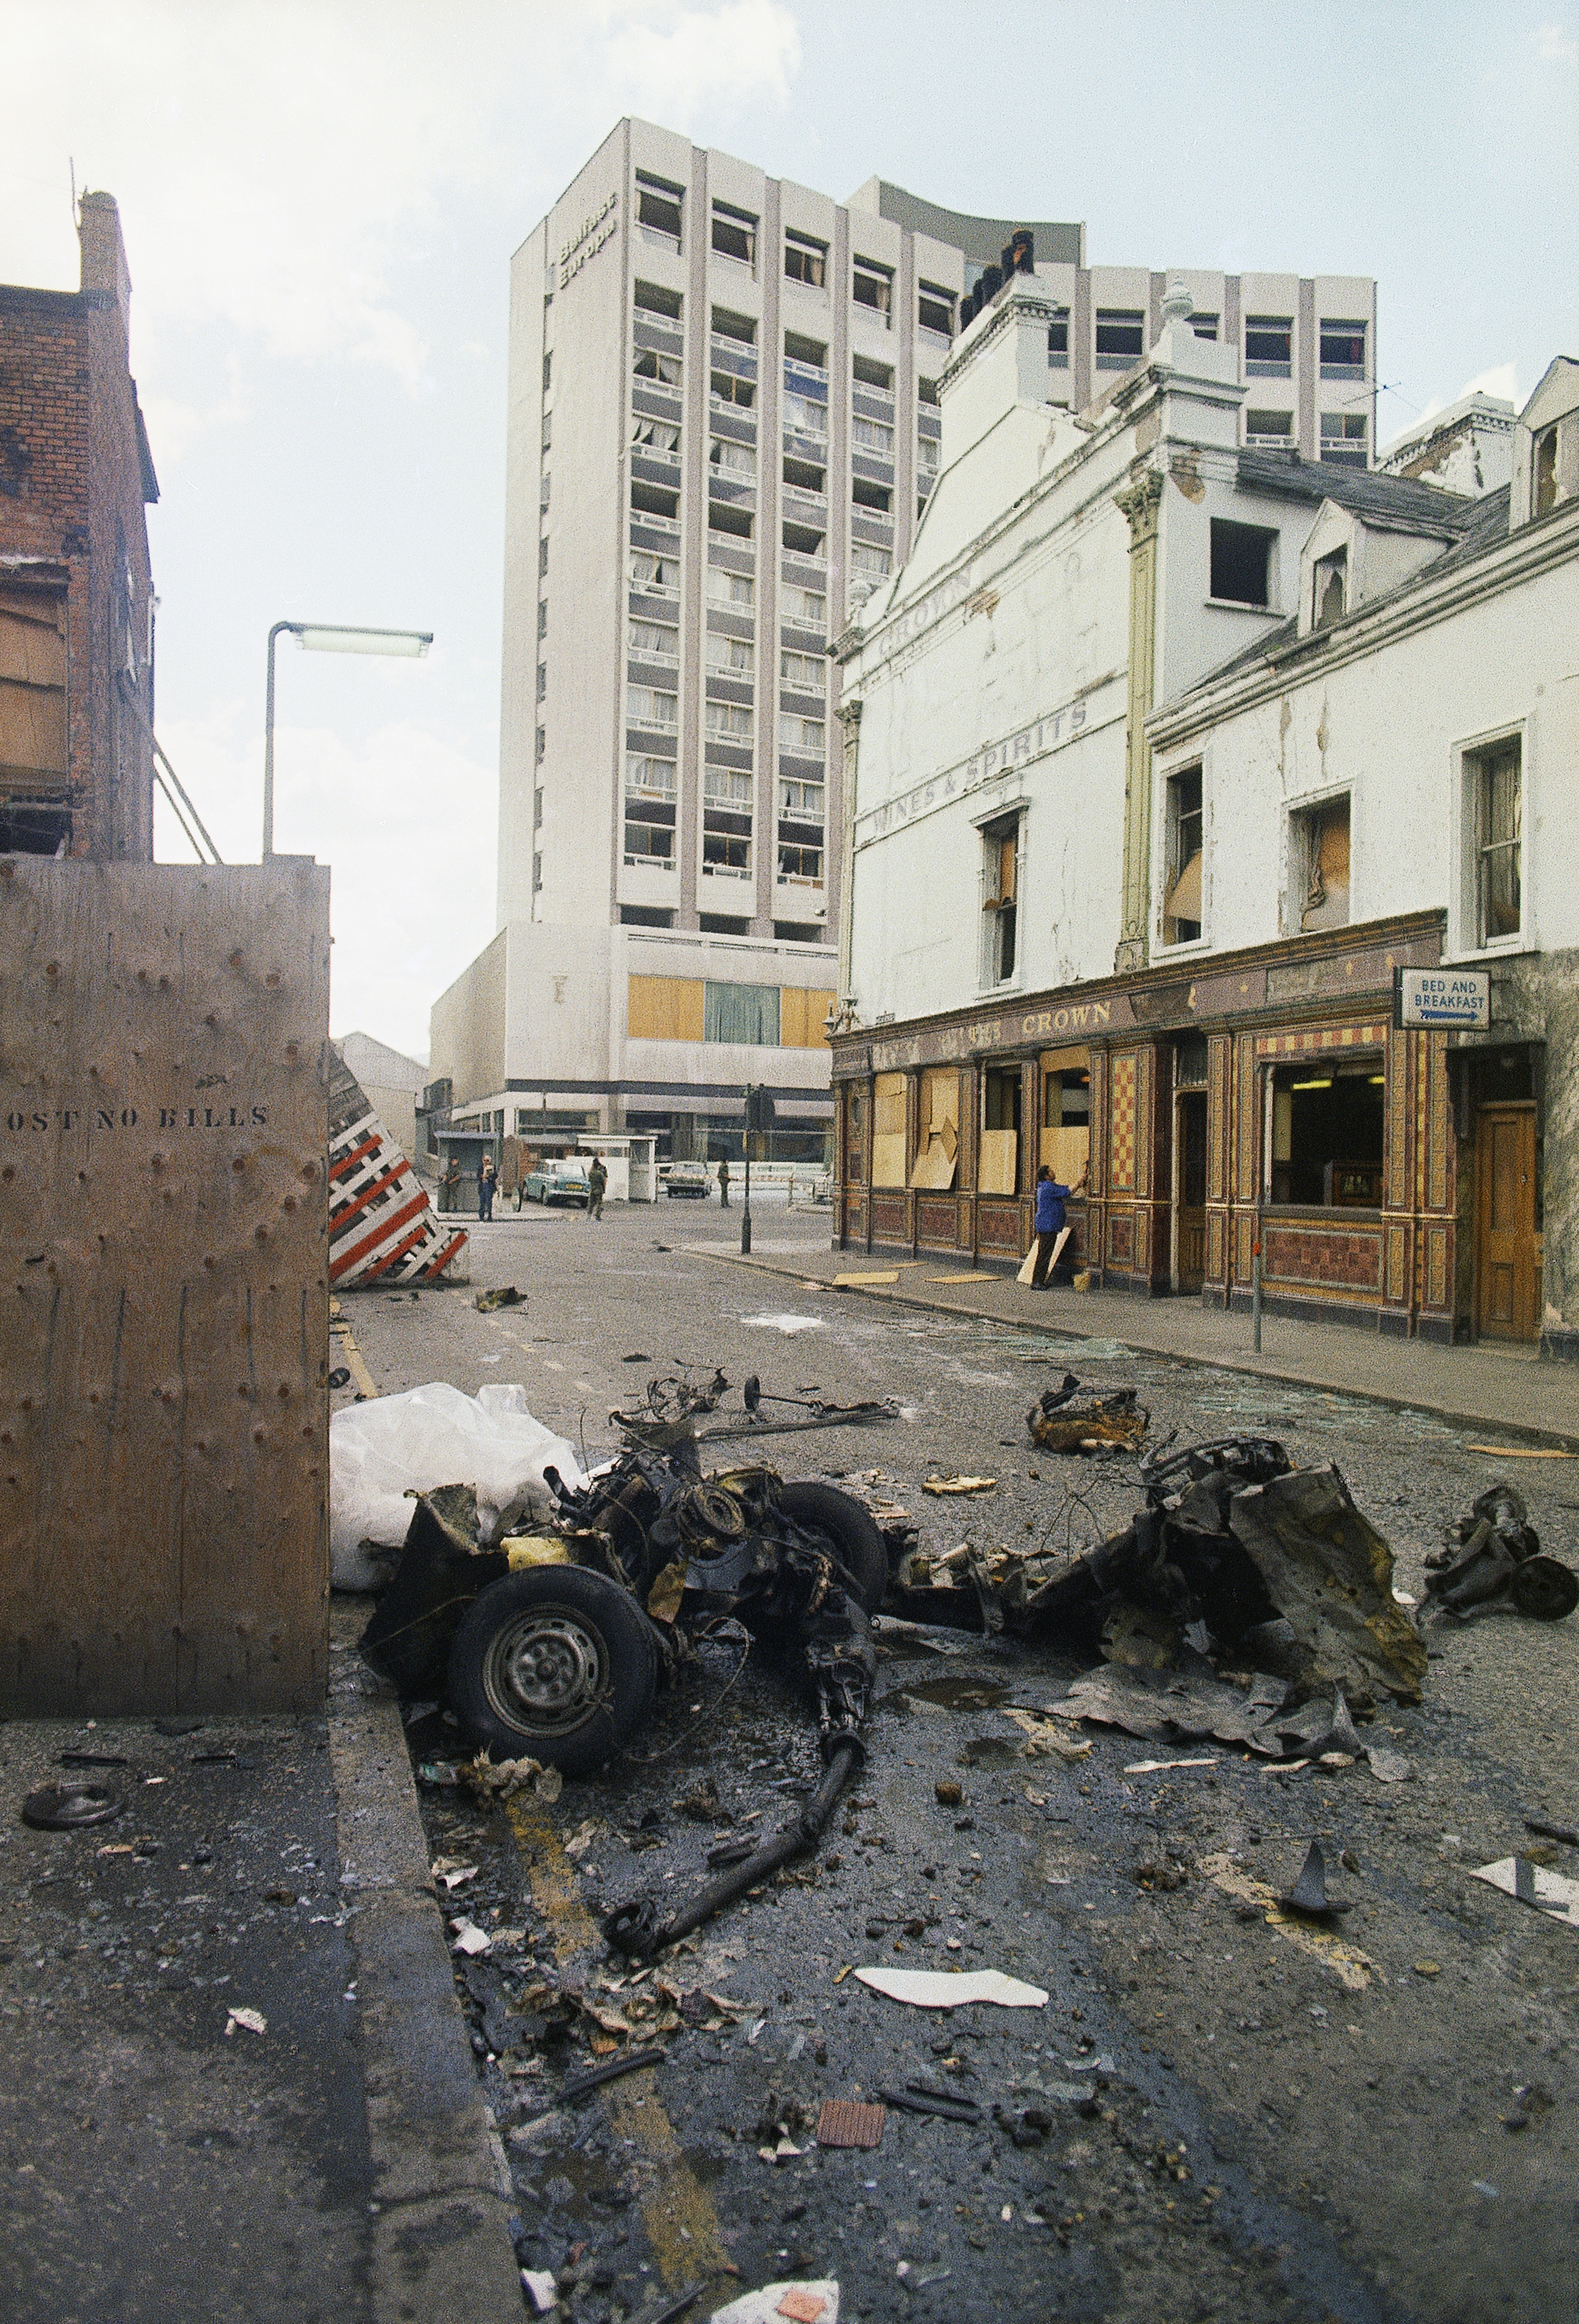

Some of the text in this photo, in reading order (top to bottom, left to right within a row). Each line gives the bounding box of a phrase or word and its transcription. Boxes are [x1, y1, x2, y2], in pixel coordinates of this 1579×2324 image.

[879, 562, 974, 658] CROWN
[965, 700, 1087, 785] SPIRITS
[1422, 979, 1477, 994] BED AND
[1415, 995, 1484, 1009] BREAKFAST
[1022, 1001, 1112, 1035] CROWN
[7, 1106, 269, 1132] OST NO BILLS
